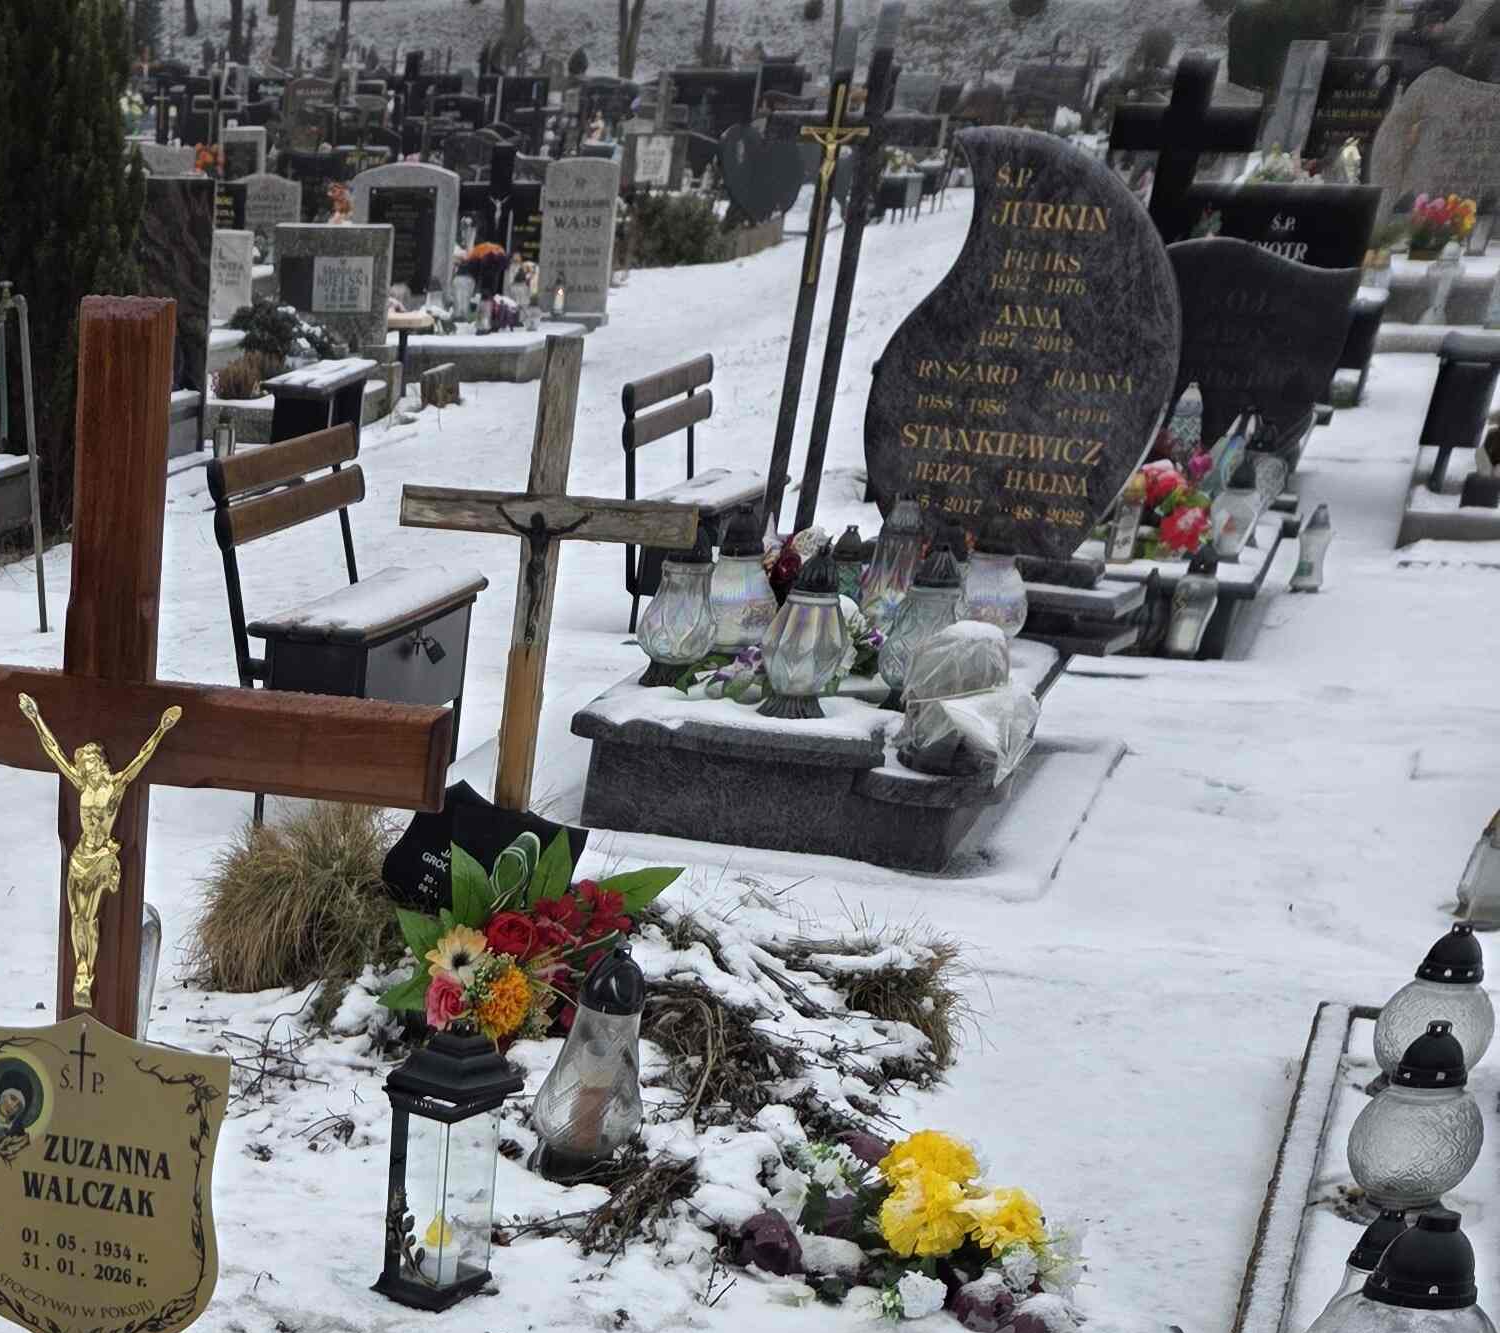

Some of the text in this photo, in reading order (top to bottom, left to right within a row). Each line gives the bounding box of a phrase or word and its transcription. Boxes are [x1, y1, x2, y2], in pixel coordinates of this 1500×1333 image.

[992, 201, 1110, 230] JURKIN
[995, 304, 1062, 329] ANNA
[916, 360, 1135, 394] RYSZARD JOANNA
[900, 424, 1106, 466] STANKIEWICZ
[908, 463, 1089, 497] JERZY HALINA
[44, 1134, 171, 1180] ZUZANNA
[22, 1171, 155, 1217] WALCZAK
[82, 1306, 96, 1318] W
[100, 1299, 156, 1319] POKOJU
